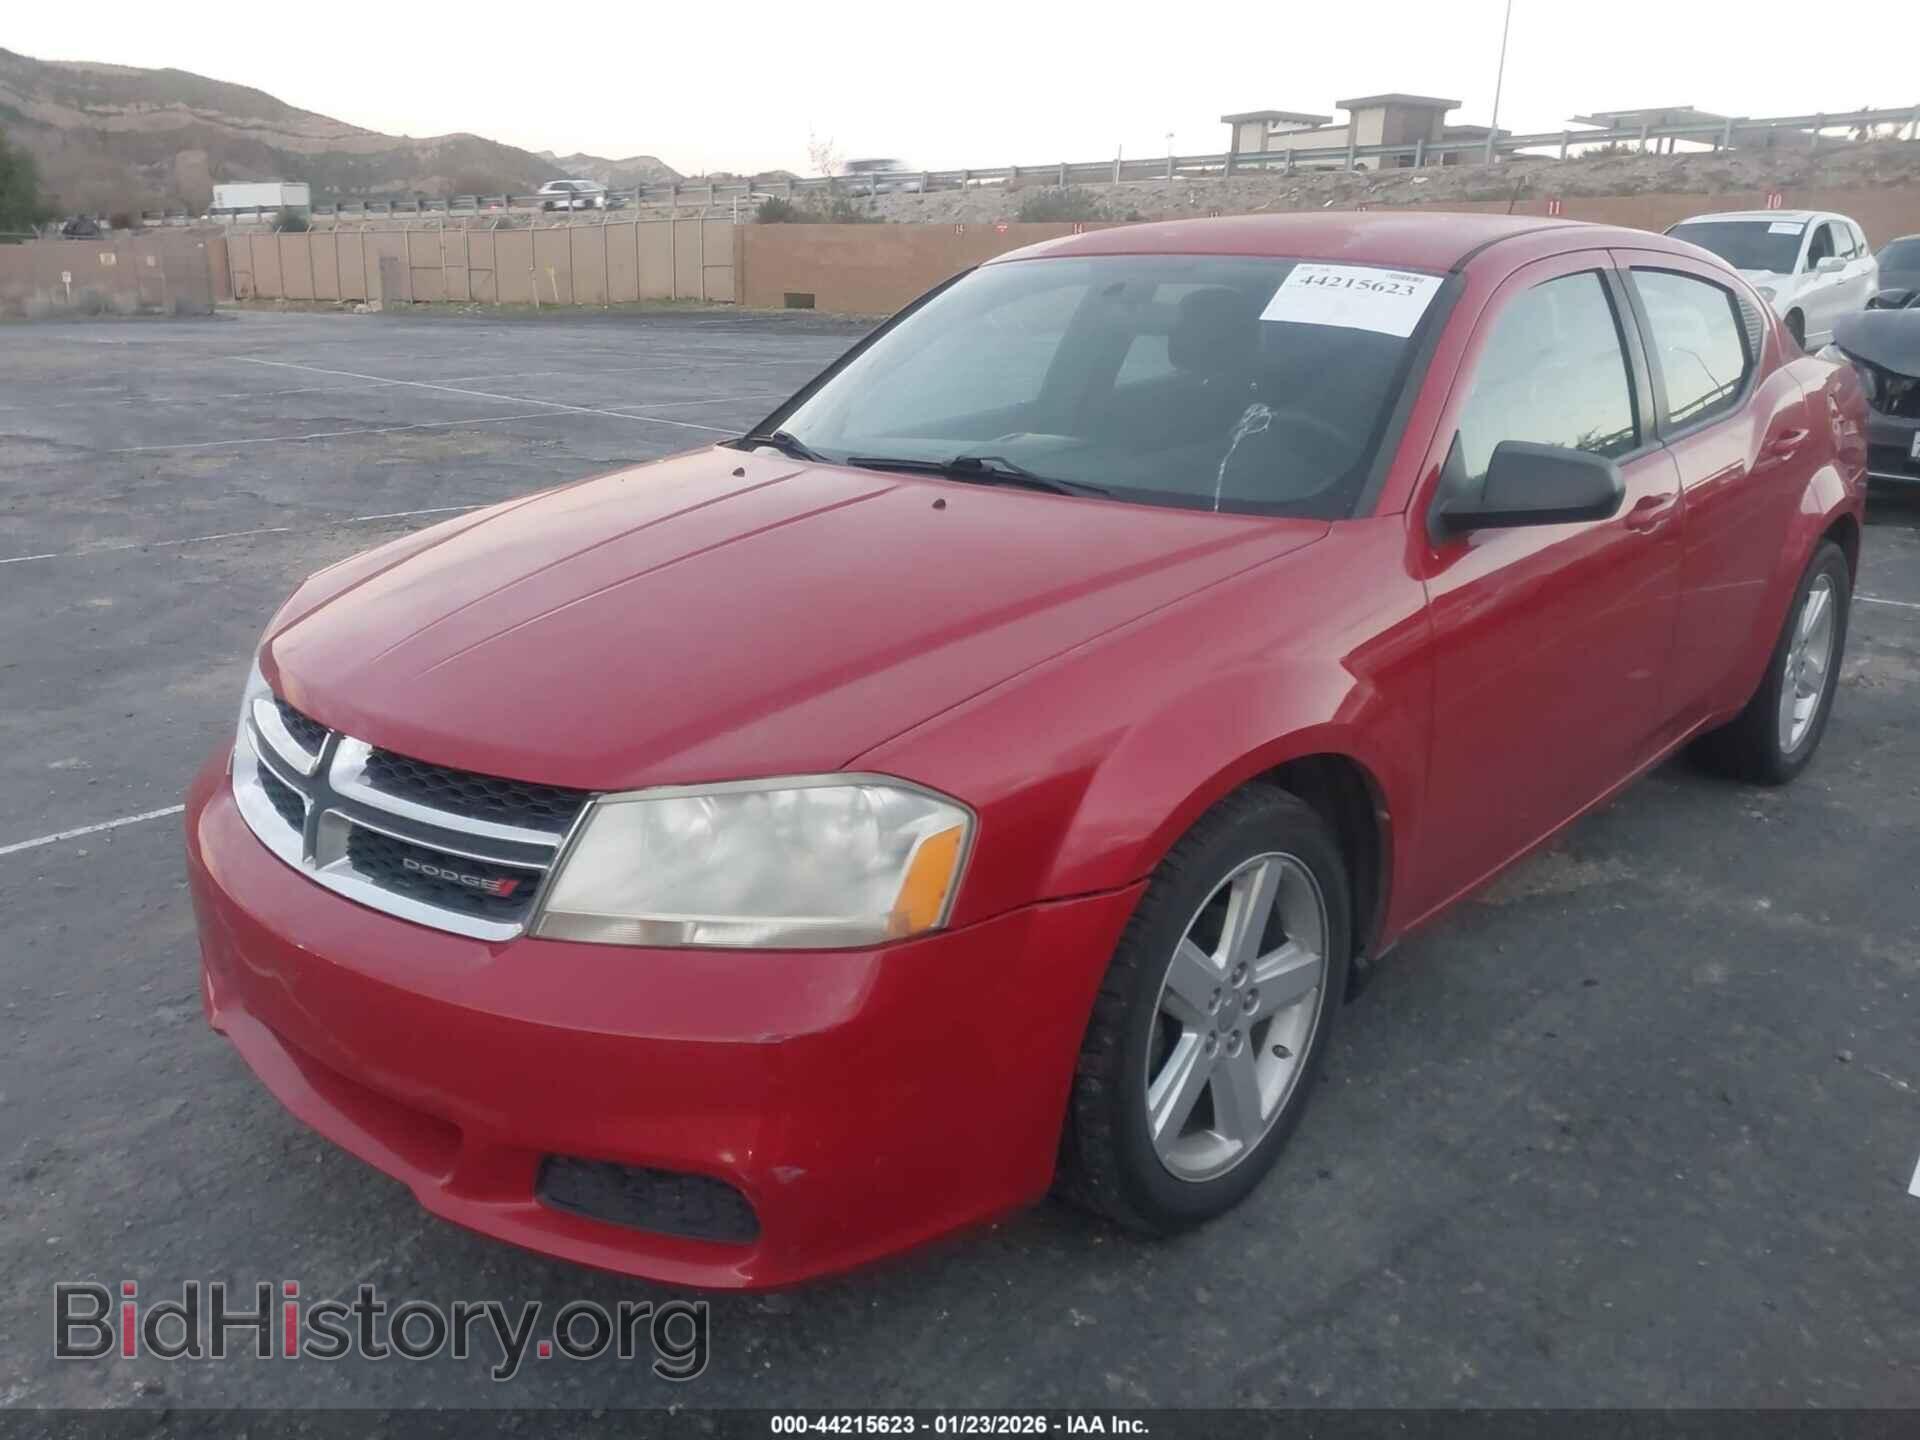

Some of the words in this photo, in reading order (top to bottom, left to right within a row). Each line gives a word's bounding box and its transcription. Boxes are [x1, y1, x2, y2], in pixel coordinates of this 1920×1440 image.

[1767, 193, 1782, 209] 10
[1300, 275, 1416, 296] 44215623
[402, 857, 501, 892] DODGE
